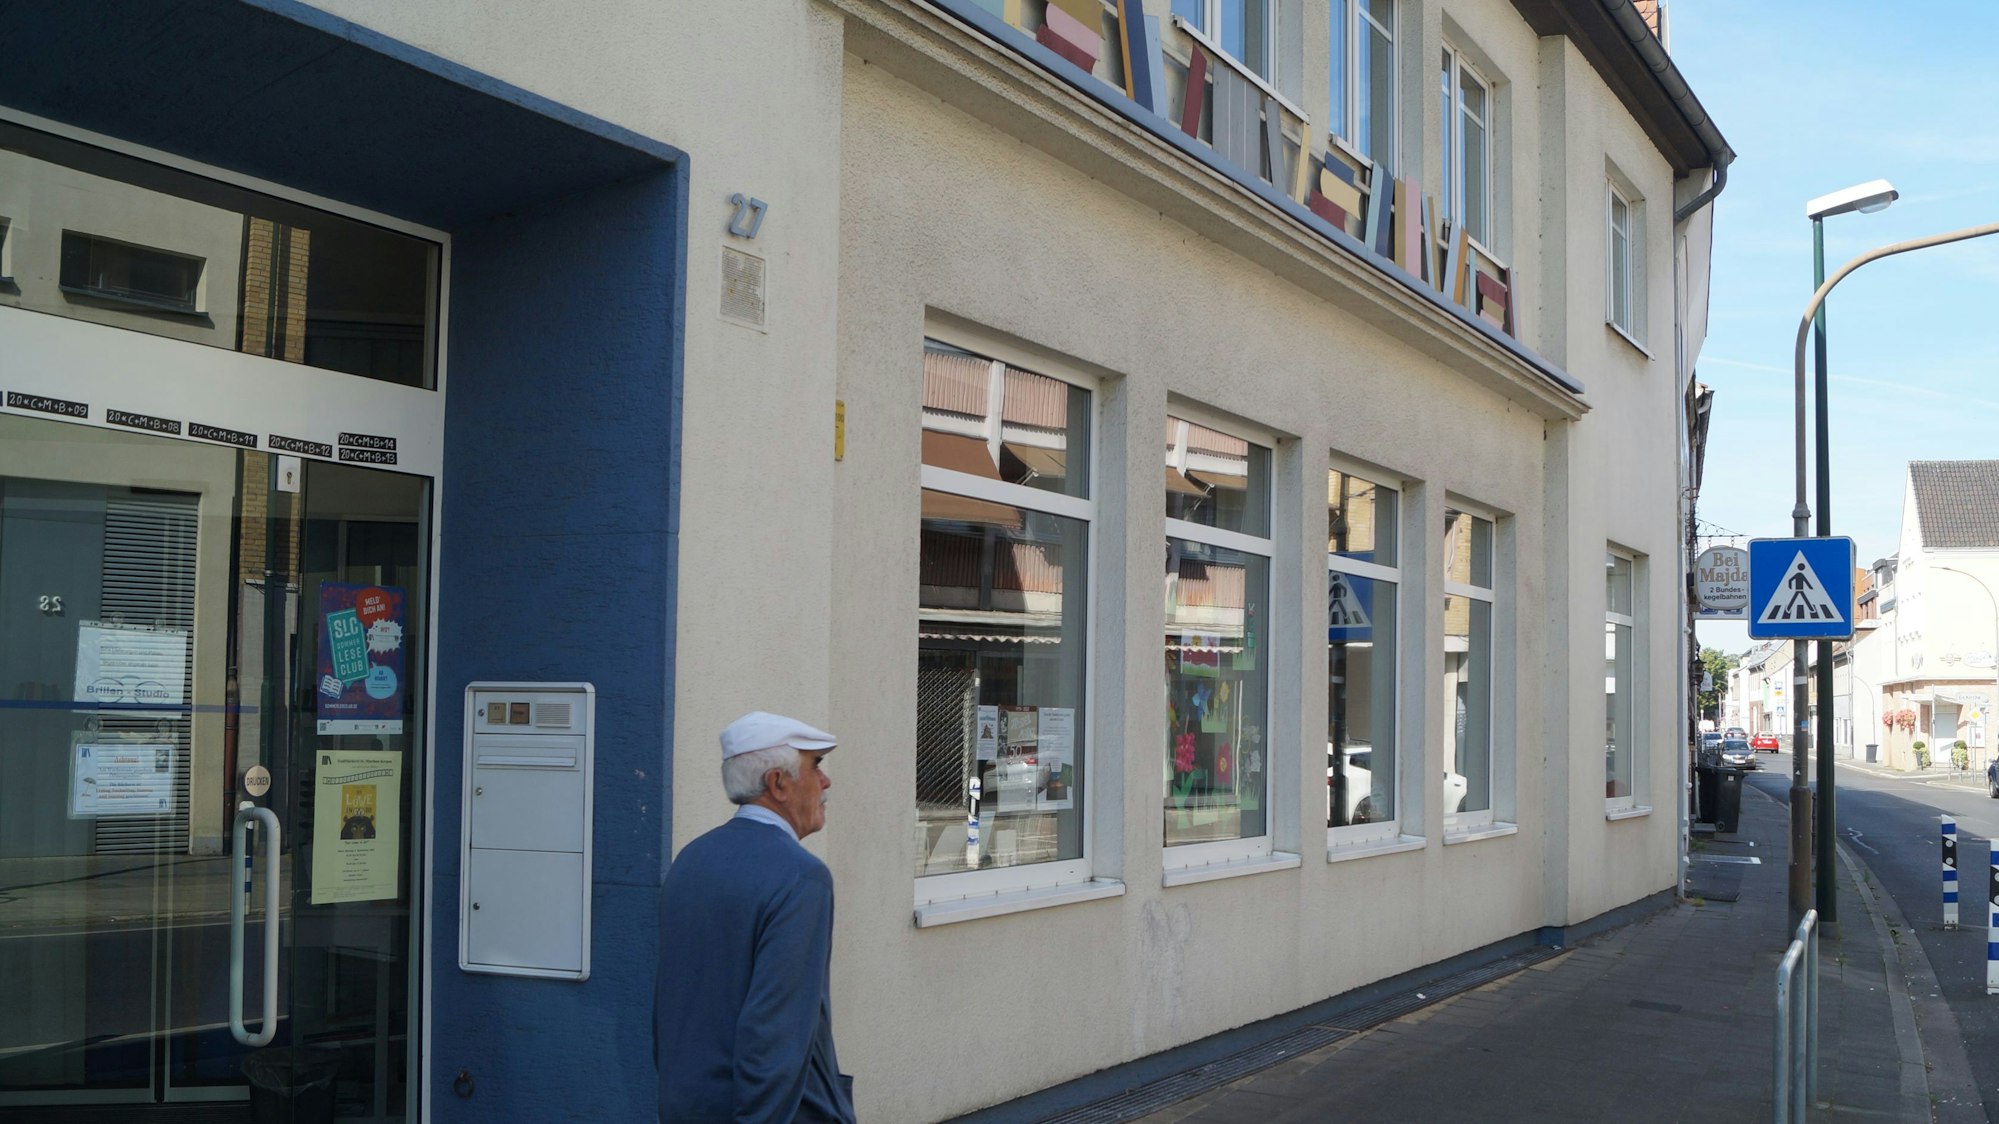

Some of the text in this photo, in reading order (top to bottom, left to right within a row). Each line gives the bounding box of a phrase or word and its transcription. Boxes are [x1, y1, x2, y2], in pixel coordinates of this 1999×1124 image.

[728, 192, 769, 240] 27
[1713, 552, 1739, 567] Bei
[1699, 567, 1748, 586] Majda
[333, 617, 359, 639] SLC
[338, 647, 362, 663] LESE
[340, 660, 364, 676] CLUB
[86, 685, 123, 696] Brillen
[134, 688, 170, 699] Studio
